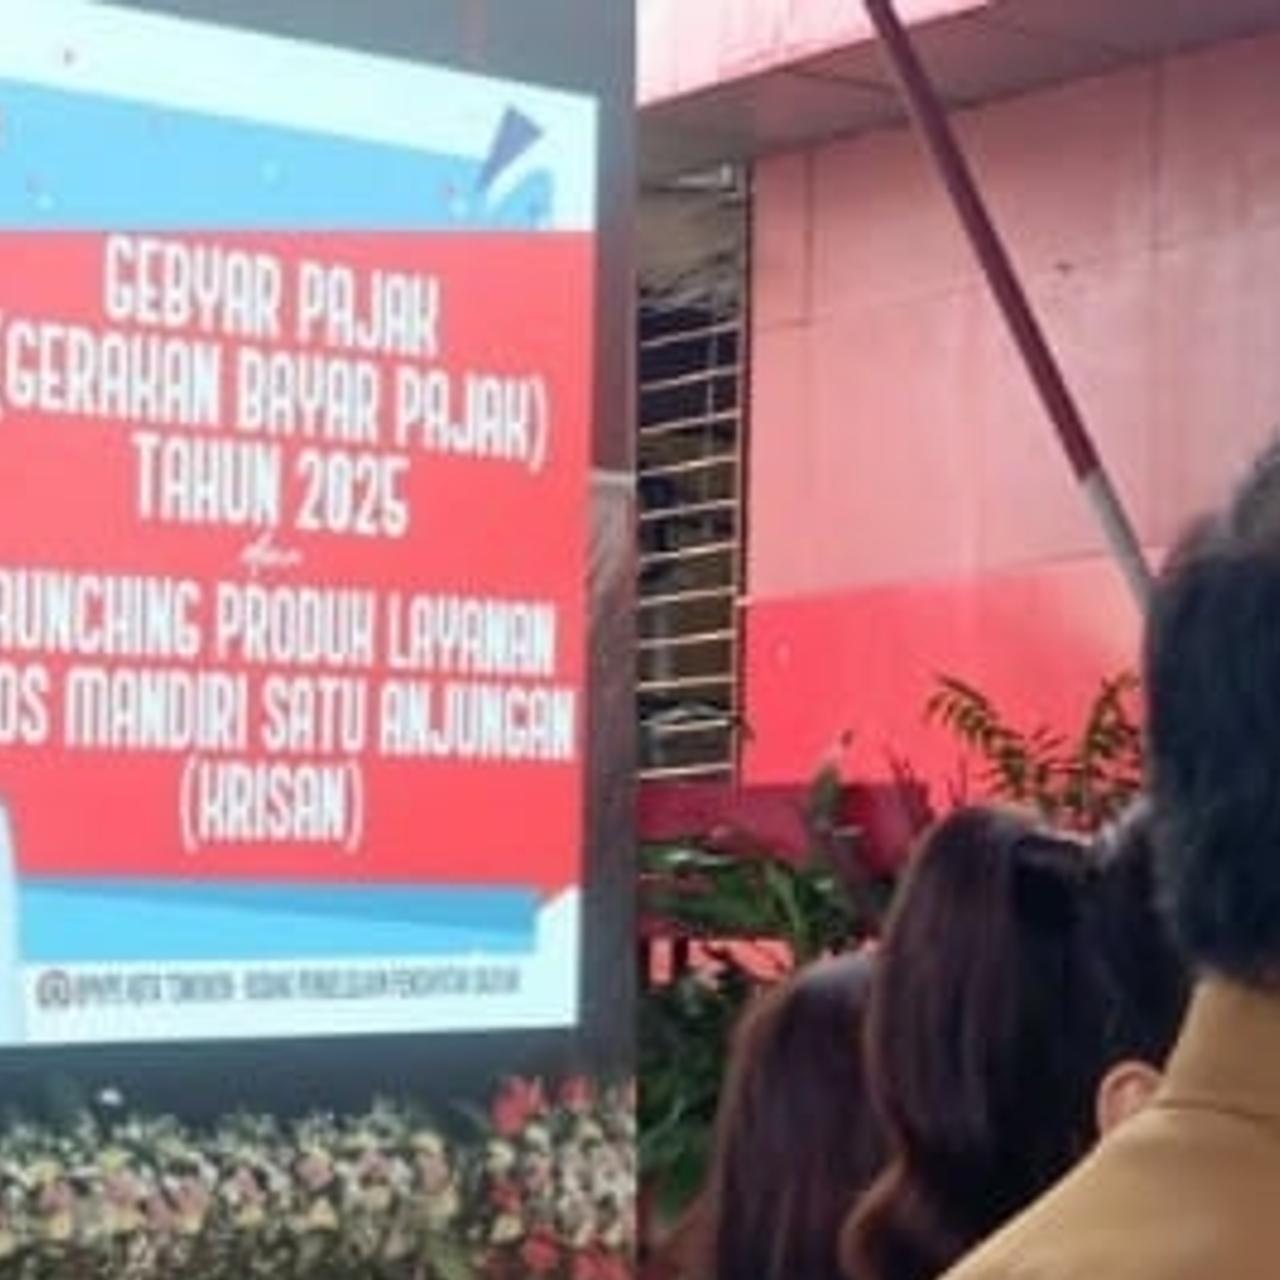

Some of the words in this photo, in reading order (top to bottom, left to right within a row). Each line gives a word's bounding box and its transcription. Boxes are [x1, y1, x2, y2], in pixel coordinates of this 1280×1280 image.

[104, 235, 279, 336] GEBYAR
[298, 263, 437, 356] PAJAK
[237, 347, 380, 443] BAYAR
[395, 367, 547, 472] PAJAK)
[133, 433, 278, 527] TAHUN
[217, 581, 373, 665] PRODUK
[388, 593, 556, 676] LAYANAN
[65, 663, 246, 751] MANDIRI
[262, 675, 365, 755] SATU
[379, 682, 576, 760] ANJUNGAN
[180, 756, 363, 853] (KRISAN)
